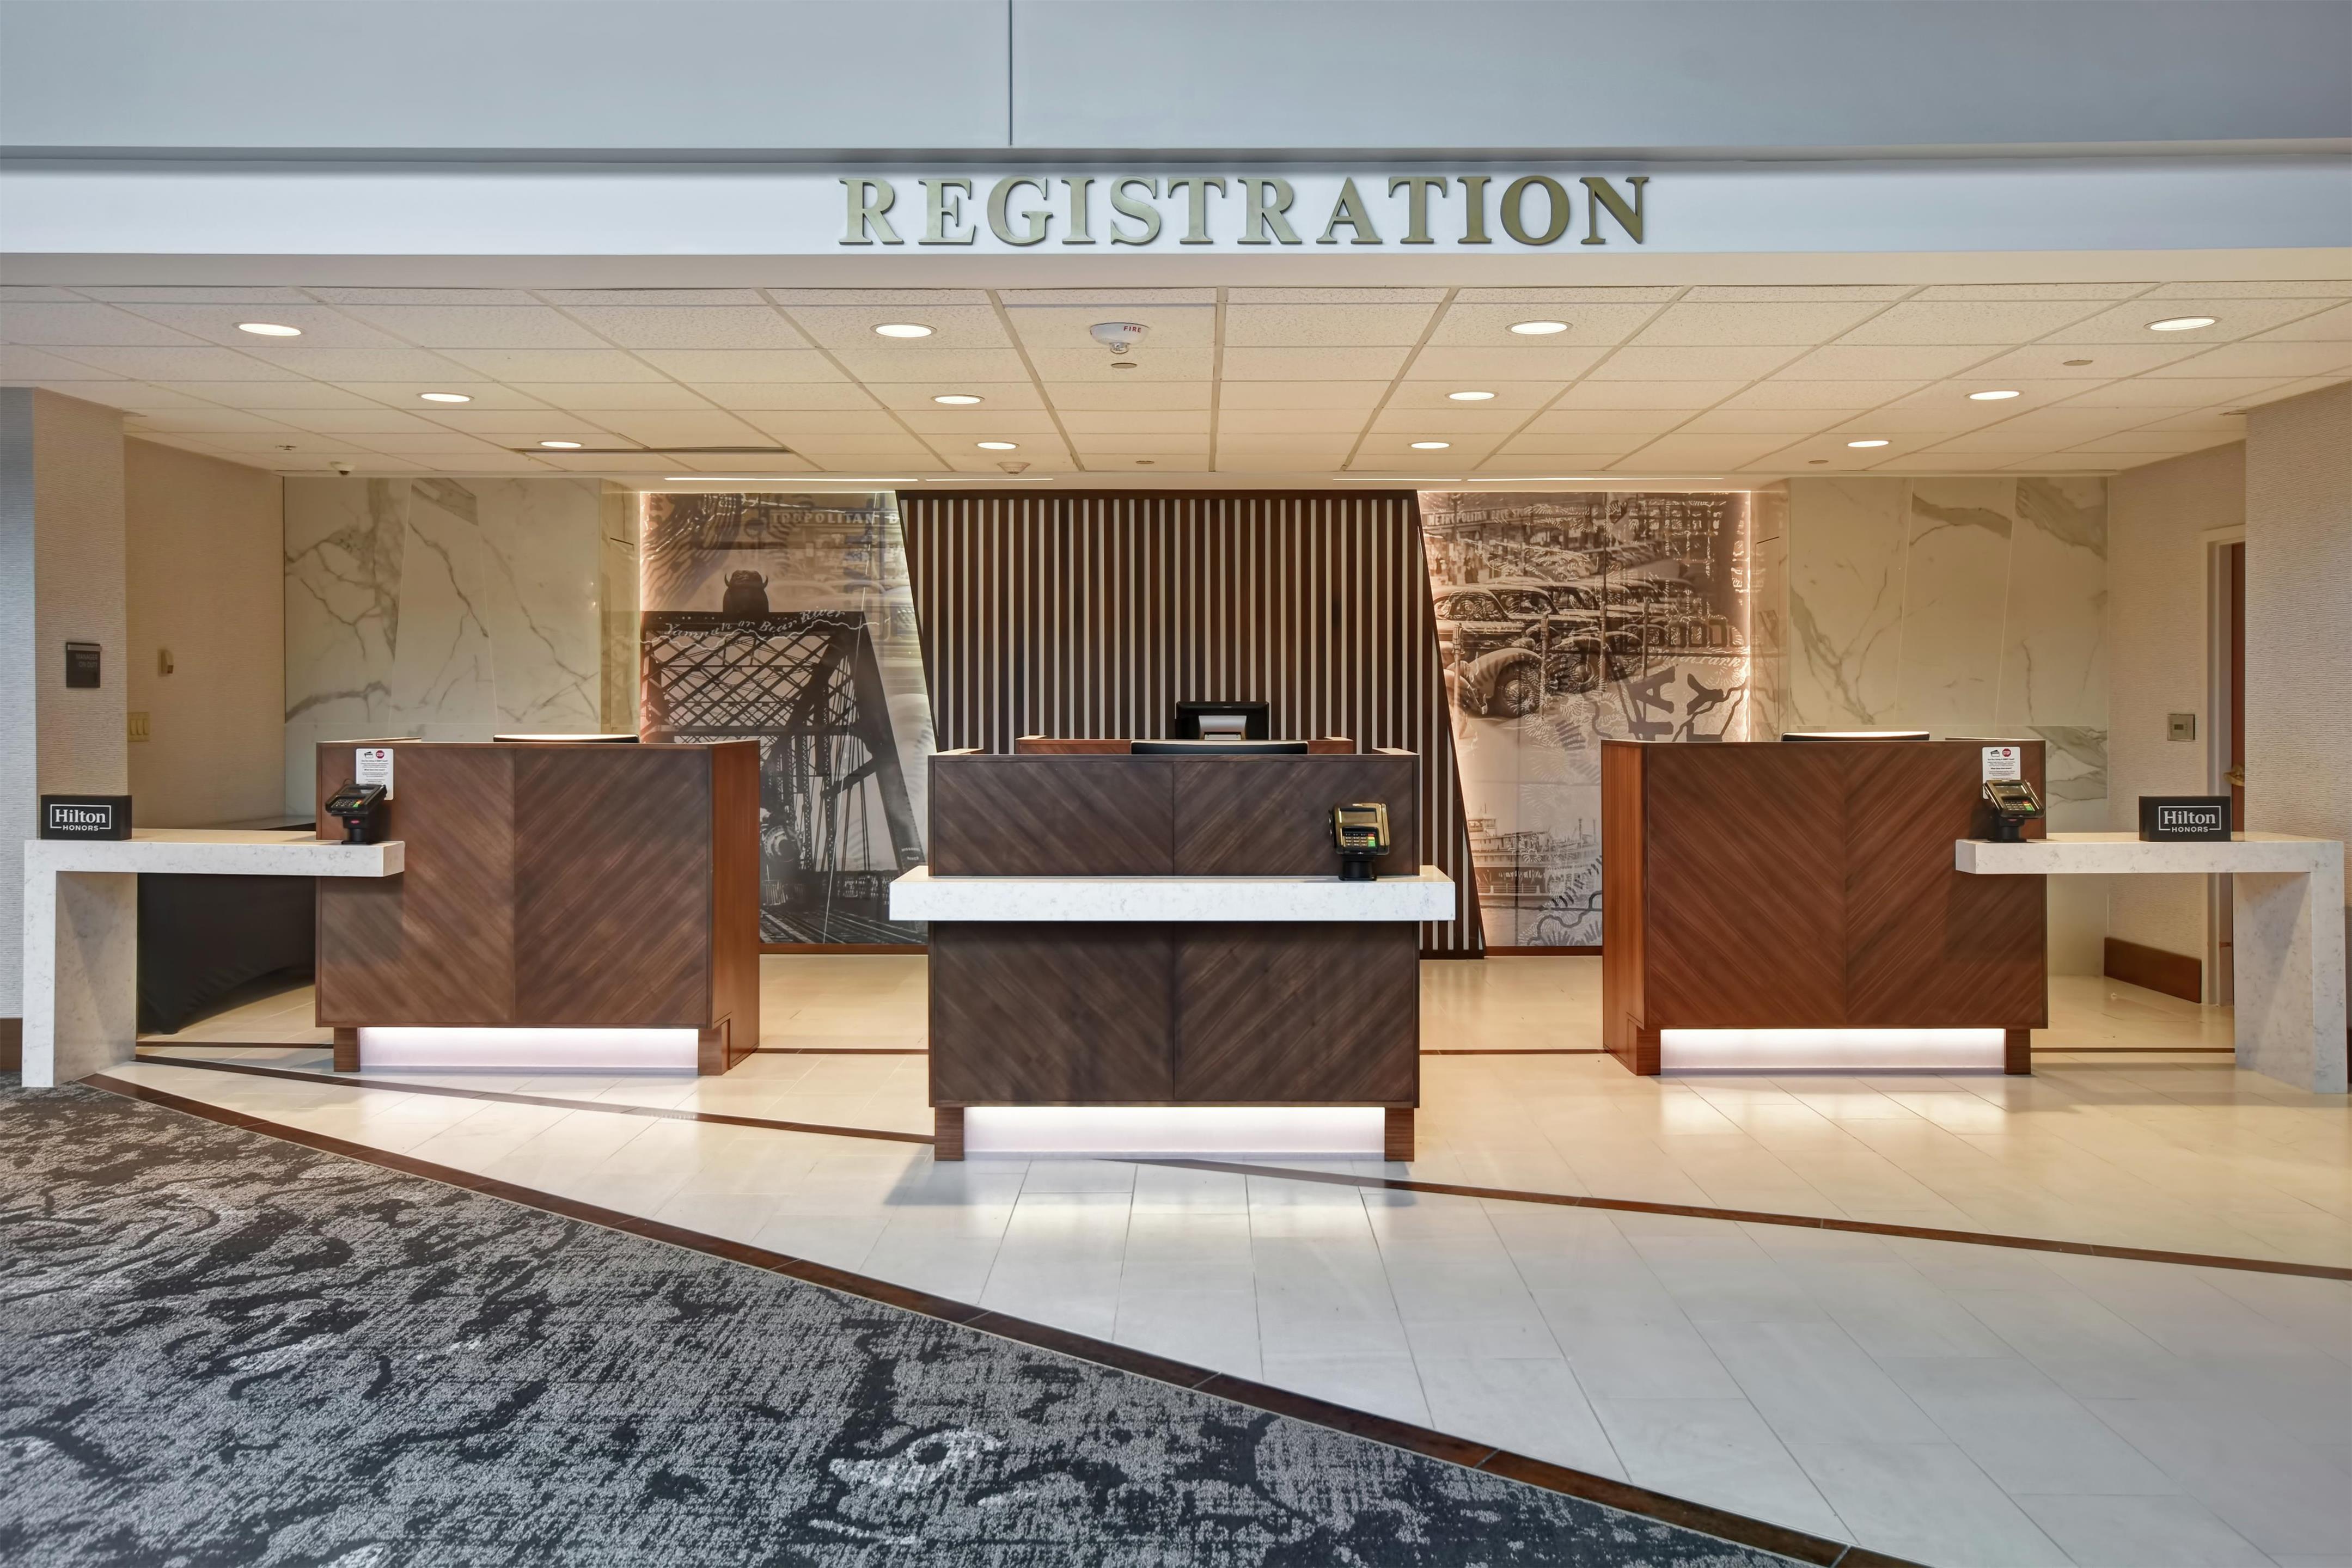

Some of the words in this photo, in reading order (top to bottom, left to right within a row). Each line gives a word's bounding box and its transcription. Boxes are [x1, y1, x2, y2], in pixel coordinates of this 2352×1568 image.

[839, 175, 1650, 246] REGISTRATION
[799, 609, 846, 623] River
[55, 808, 106, 823] Hilton
[2164, 811, 2216, 824] Hilton
